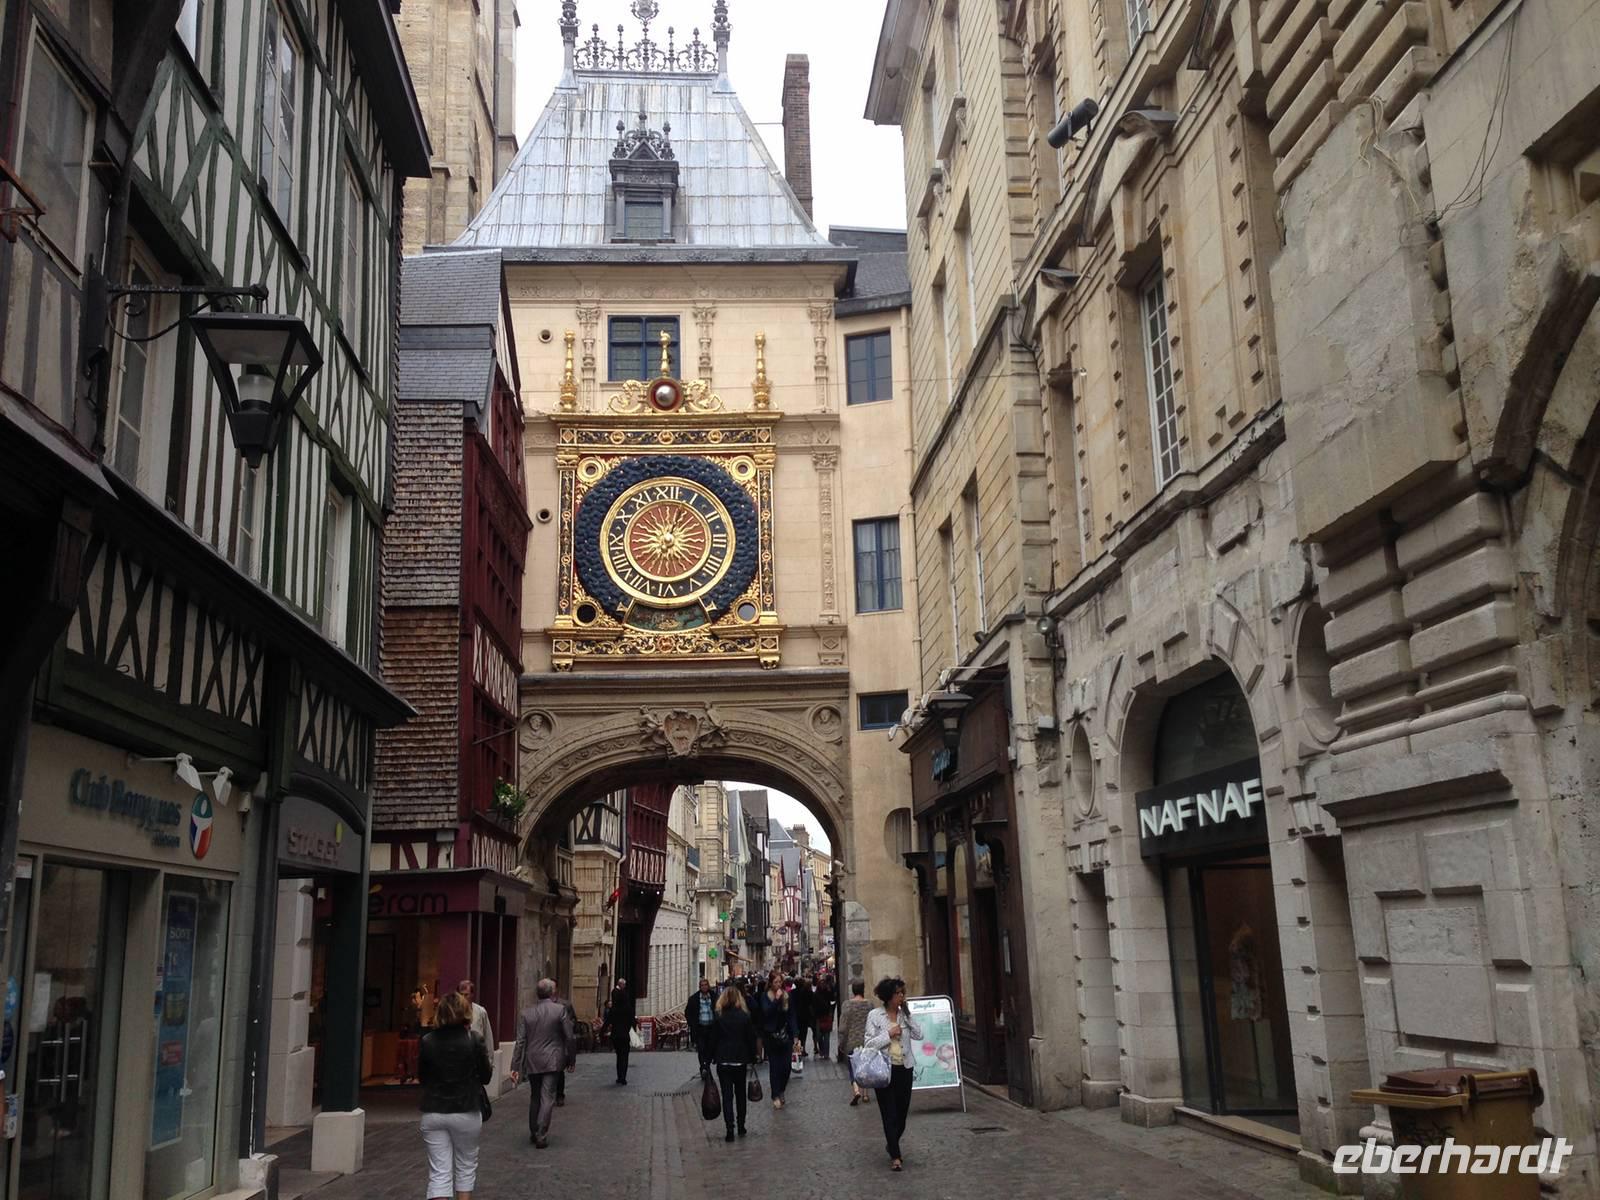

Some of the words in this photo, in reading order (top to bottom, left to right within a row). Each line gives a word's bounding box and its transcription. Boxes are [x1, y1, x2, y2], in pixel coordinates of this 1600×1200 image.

[631, 490, 652, 510] XI
[656, 487, 680, 500] XII
[689, 493, 699, 505] I
[615, 509, 633, 526] X
[704, 510, 721, 523] II
[609, 533, 624, 551] IX
[712, 533, 727, 548] III
[612, 554, 632, 580] VIII
[702, 554, 723, 577] IIII
[629, 576, 651, 595] VII
[657, 583, 678, 598] VI
[689, 578, 703, 593] V
